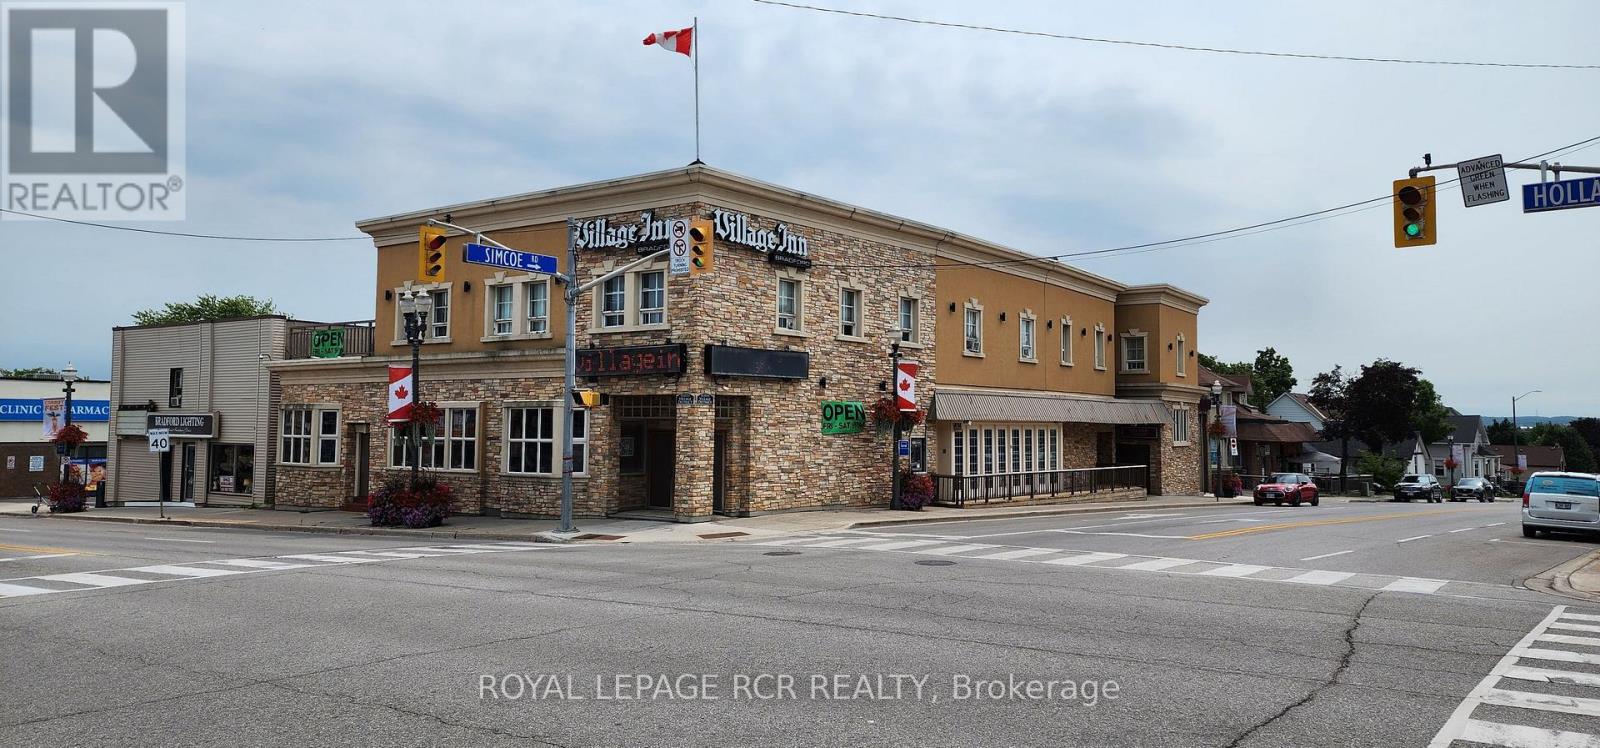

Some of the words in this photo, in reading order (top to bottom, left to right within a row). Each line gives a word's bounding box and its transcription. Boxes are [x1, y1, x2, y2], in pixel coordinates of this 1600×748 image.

[1460, 160, 1501, 173] ADVANCED
[1470, 171, 1496, 182] GREEN
[1473, 181, 1496, 191] WHEN
[1467, 189, 1505, 202] FLASHING
[574, 218, 638, 249] Village
[713, 208, 777, 252] Village
[778, 223, 809, 256] Inn
[484, 247, 524, 268] SIMCOE
[531, 255, 539, 264] RD
[775, 254, 811, 267] BRADFORD
[314, 331, 345, 347] OPEN
[0, 405, 42, 414] CLINIC
[69, 406, 109, 415] ARMAC
[823, 404, 866, 421] OPEN
[155, 416, 180, 426] BRADFORD
[180, 416, 205, 427] LIGHTING
[151, 438, 168, 449] 40
